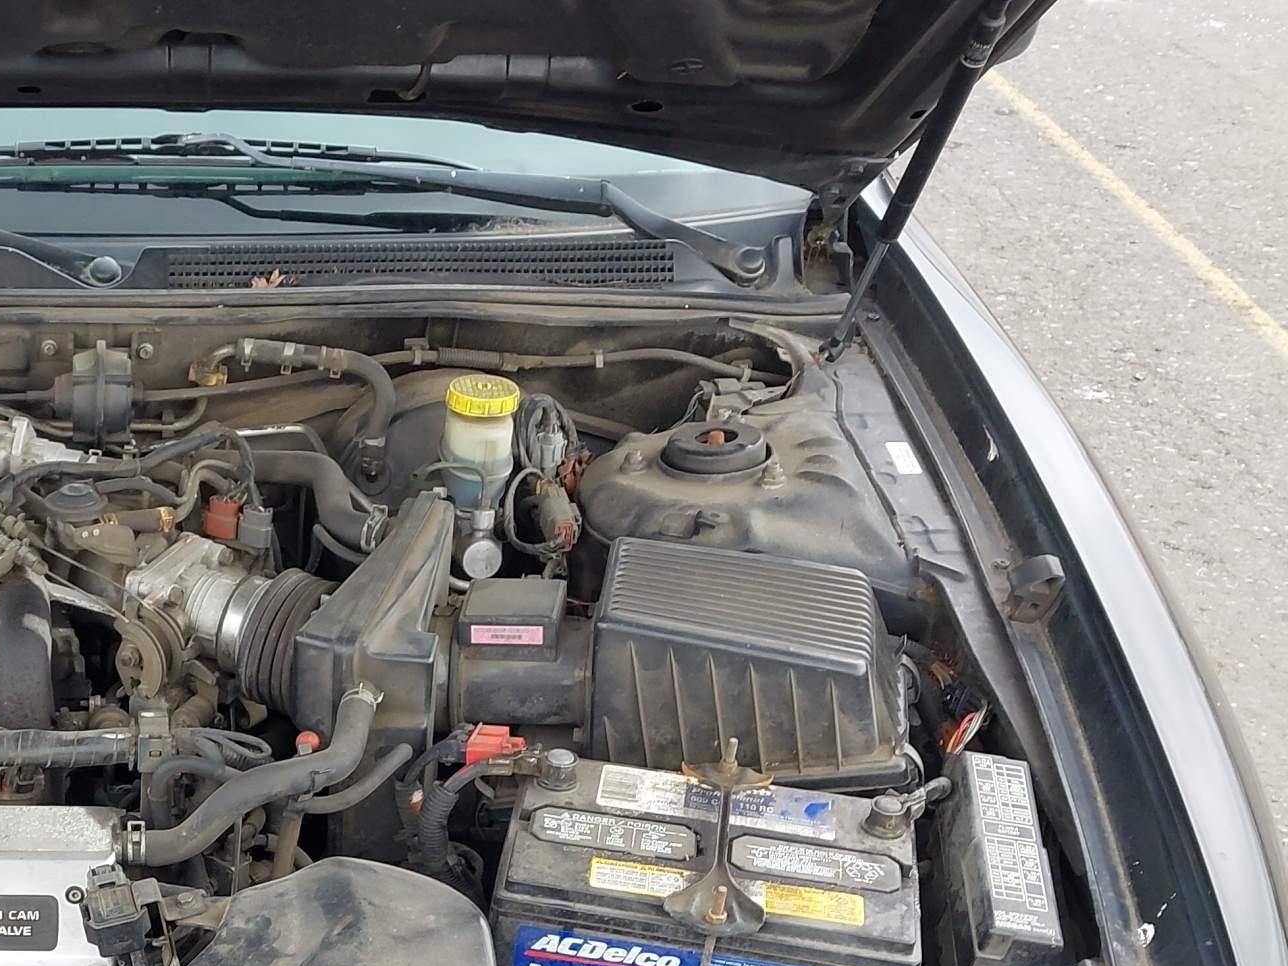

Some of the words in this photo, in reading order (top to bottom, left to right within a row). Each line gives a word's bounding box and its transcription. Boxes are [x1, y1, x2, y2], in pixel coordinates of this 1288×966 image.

[572, 813, 616, 826] DANGER
[626, 821, 667, 832] POISON
[8, 910, 40, 921] CAM
